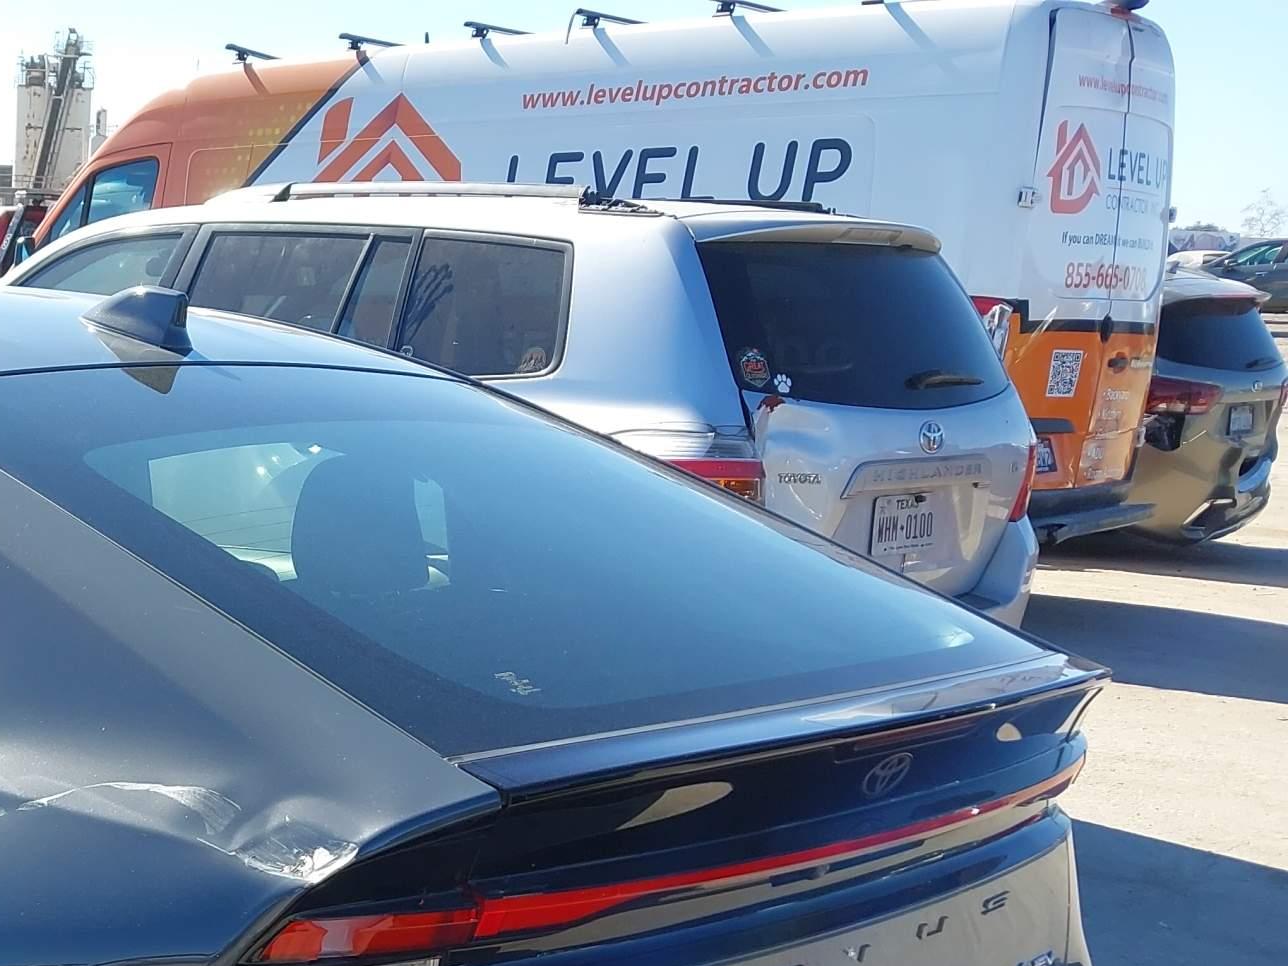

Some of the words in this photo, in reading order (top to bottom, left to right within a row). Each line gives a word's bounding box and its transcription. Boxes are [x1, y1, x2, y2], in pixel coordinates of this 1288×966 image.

[521, 67, 869, 110] www.levelupcontractor.com
[747, 138, 853, 201] UP
[1107, 147, 1152, 186] LEVEL
[1068, 234, 1082, 247] you
[1082, 235, 1094, 245] can
[777, 472, 822, 485] TOYOTA
[872, 463, 982, 482] HIGHLANDER
